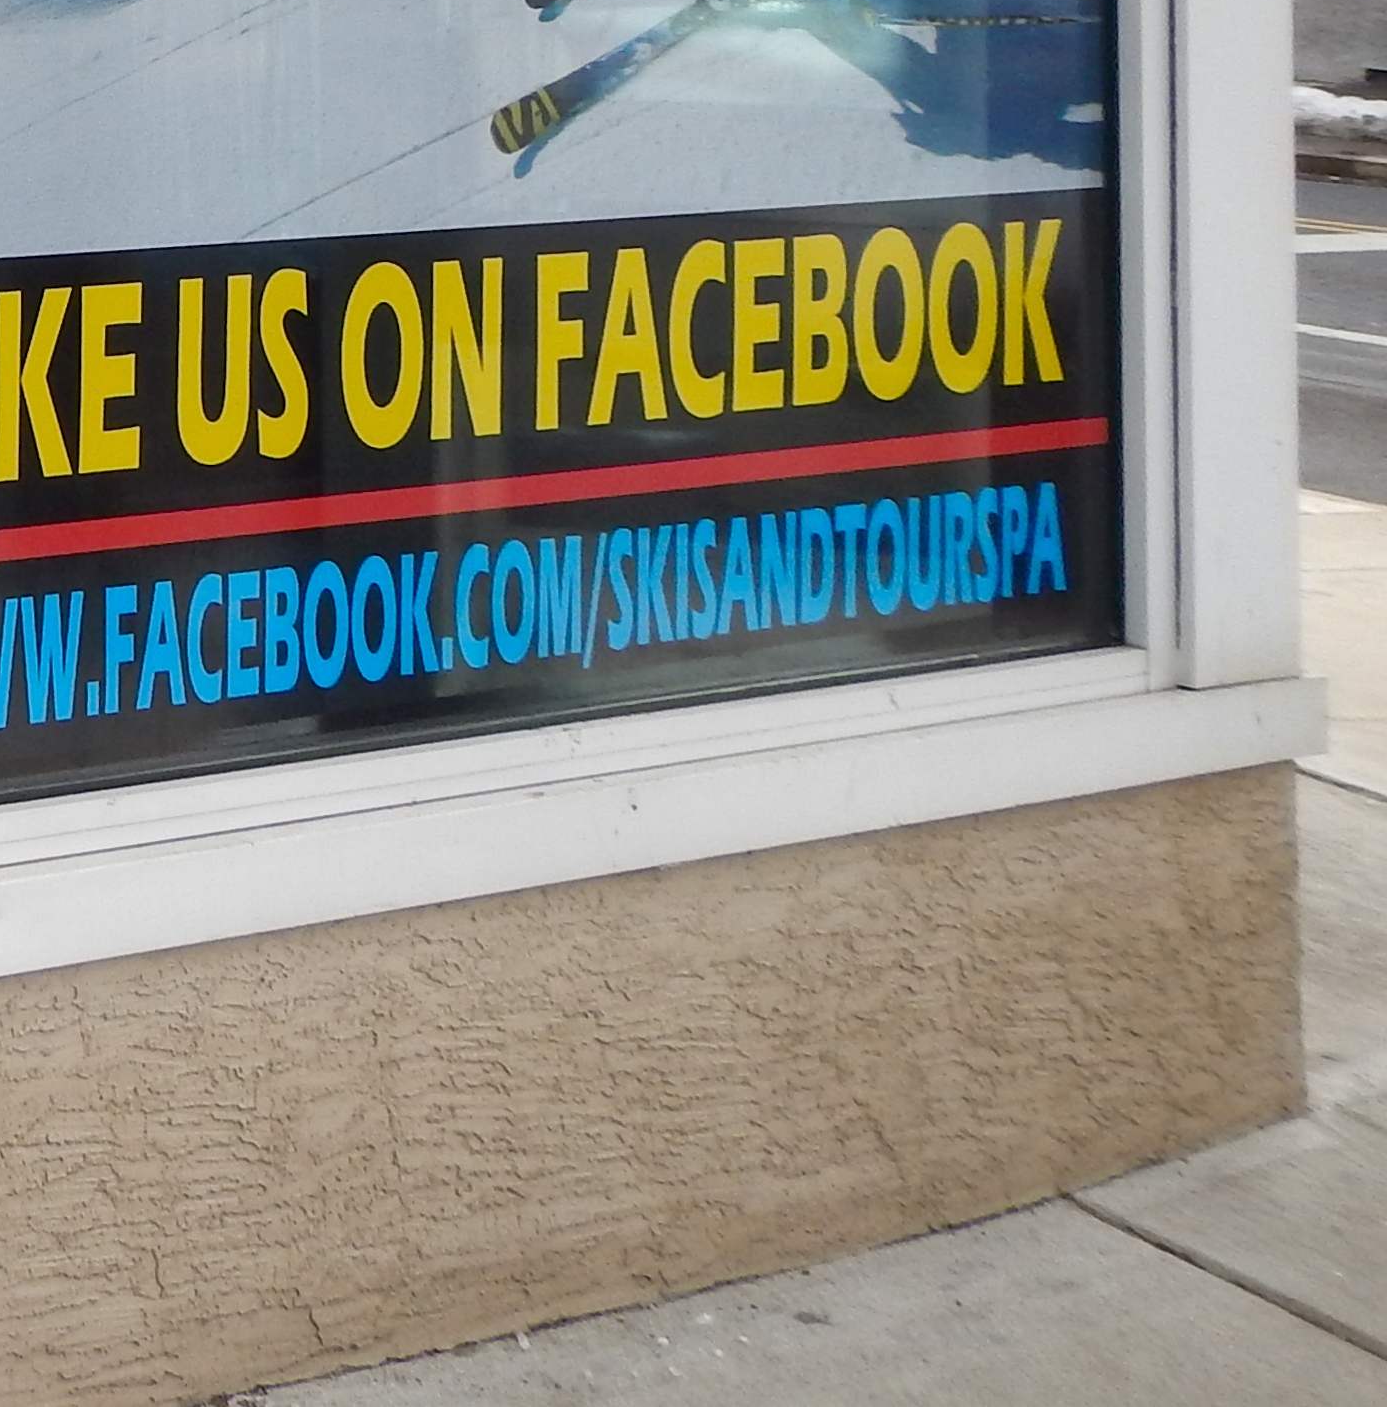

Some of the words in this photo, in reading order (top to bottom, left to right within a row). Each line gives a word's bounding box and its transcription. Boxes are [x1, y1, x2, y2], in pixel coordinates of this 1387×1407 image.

[176, 267, 310, 467] US
[340, 256, 505, 451] ON
[534, 218, 1066, 432] FACEBOOK
